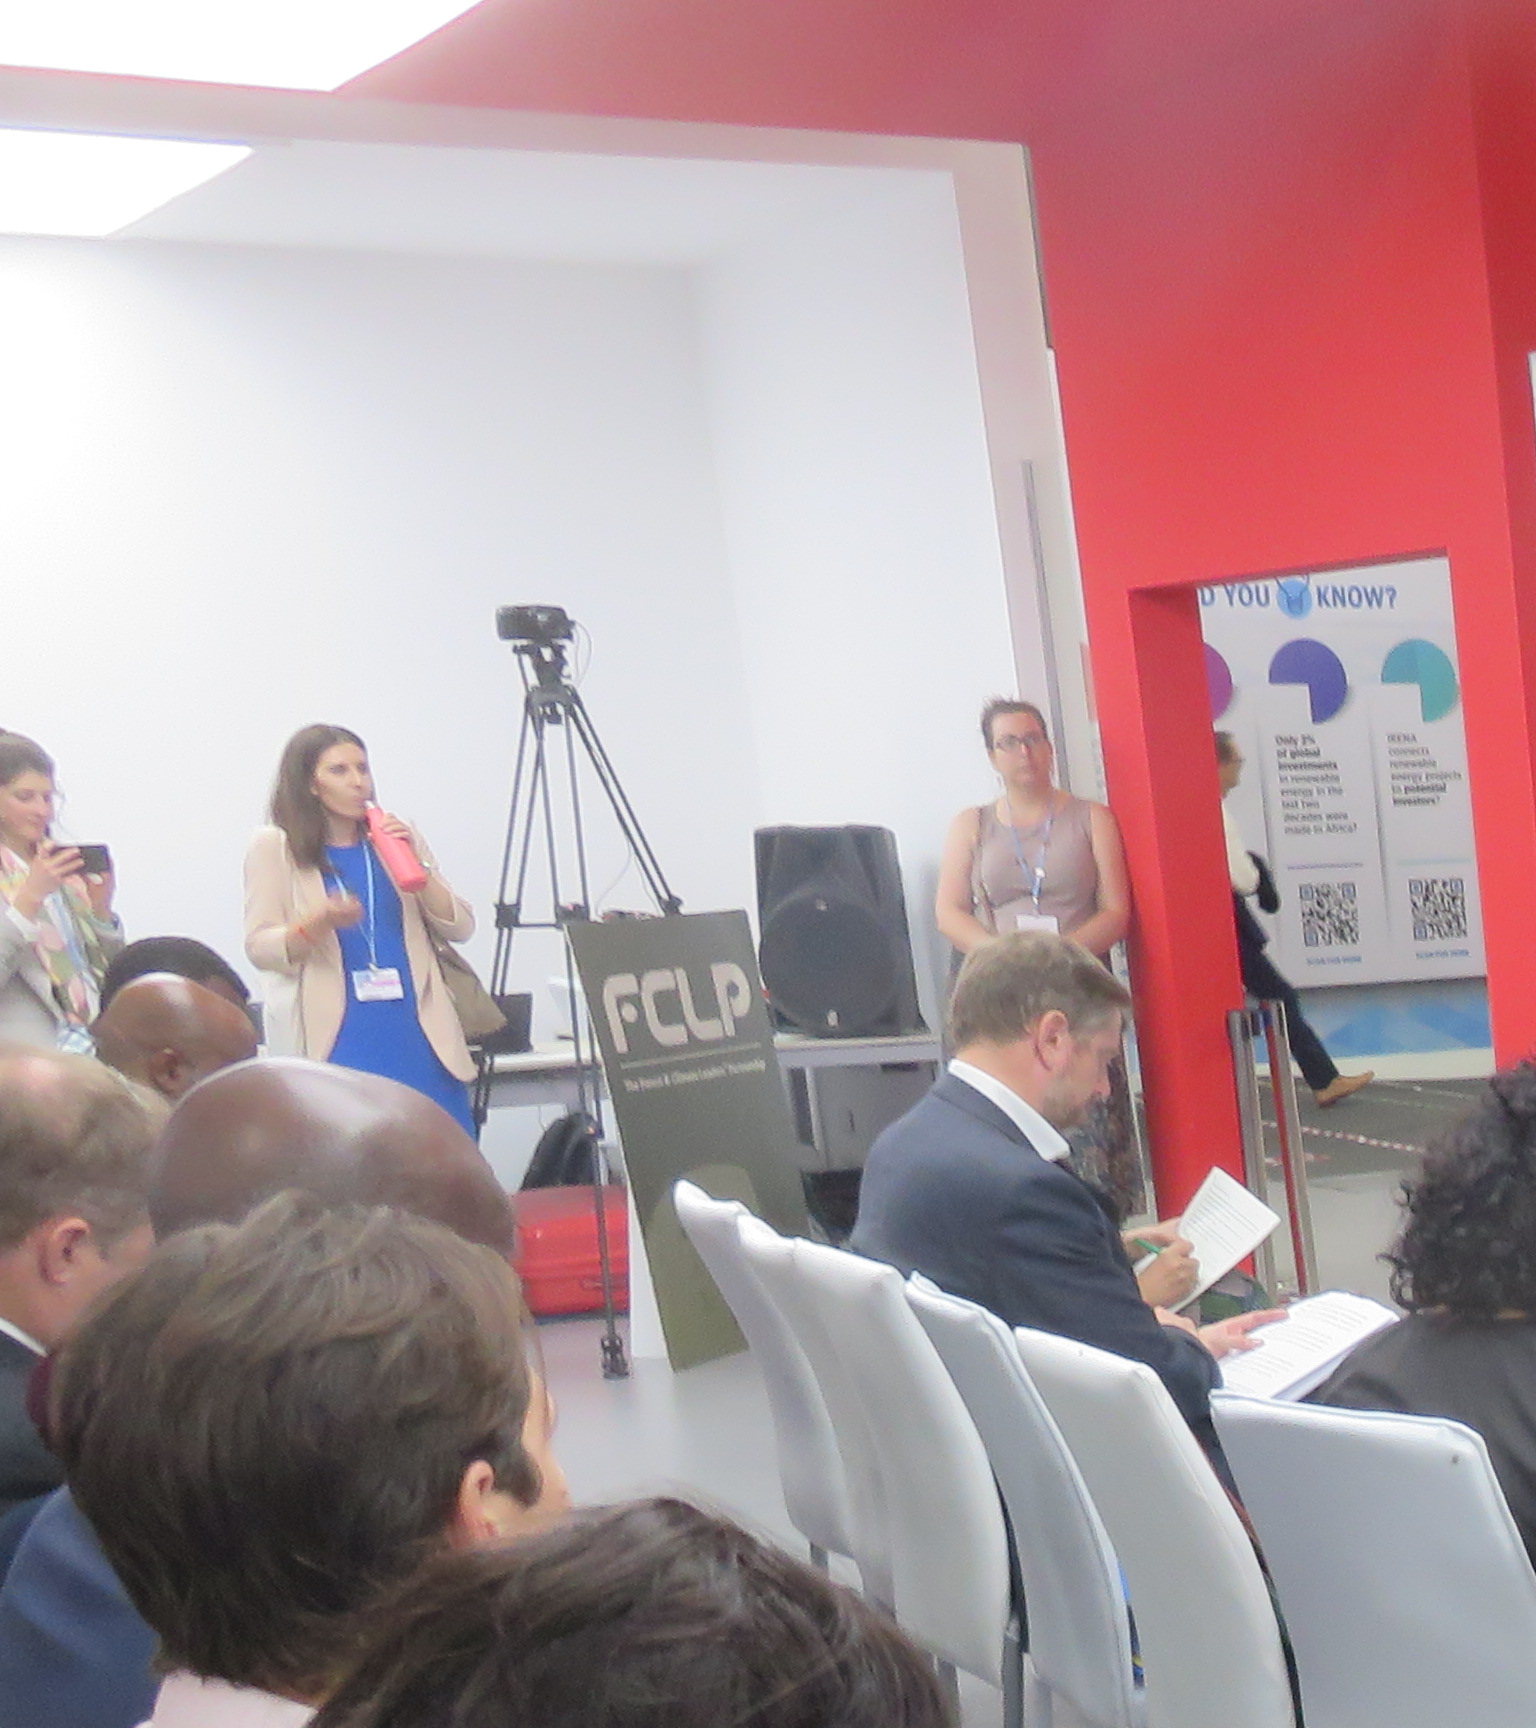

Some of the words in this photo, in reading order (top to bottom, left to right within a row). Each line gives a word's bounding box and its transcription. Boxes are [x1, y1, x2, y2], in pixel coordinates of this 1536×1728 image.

[1200, 586, 1215, 606] D
[1224, 583, 1270, 607] YOU
[1316, 584, 1397, 609] KNOW?
[602, 962, 752, 1055] FCLP
